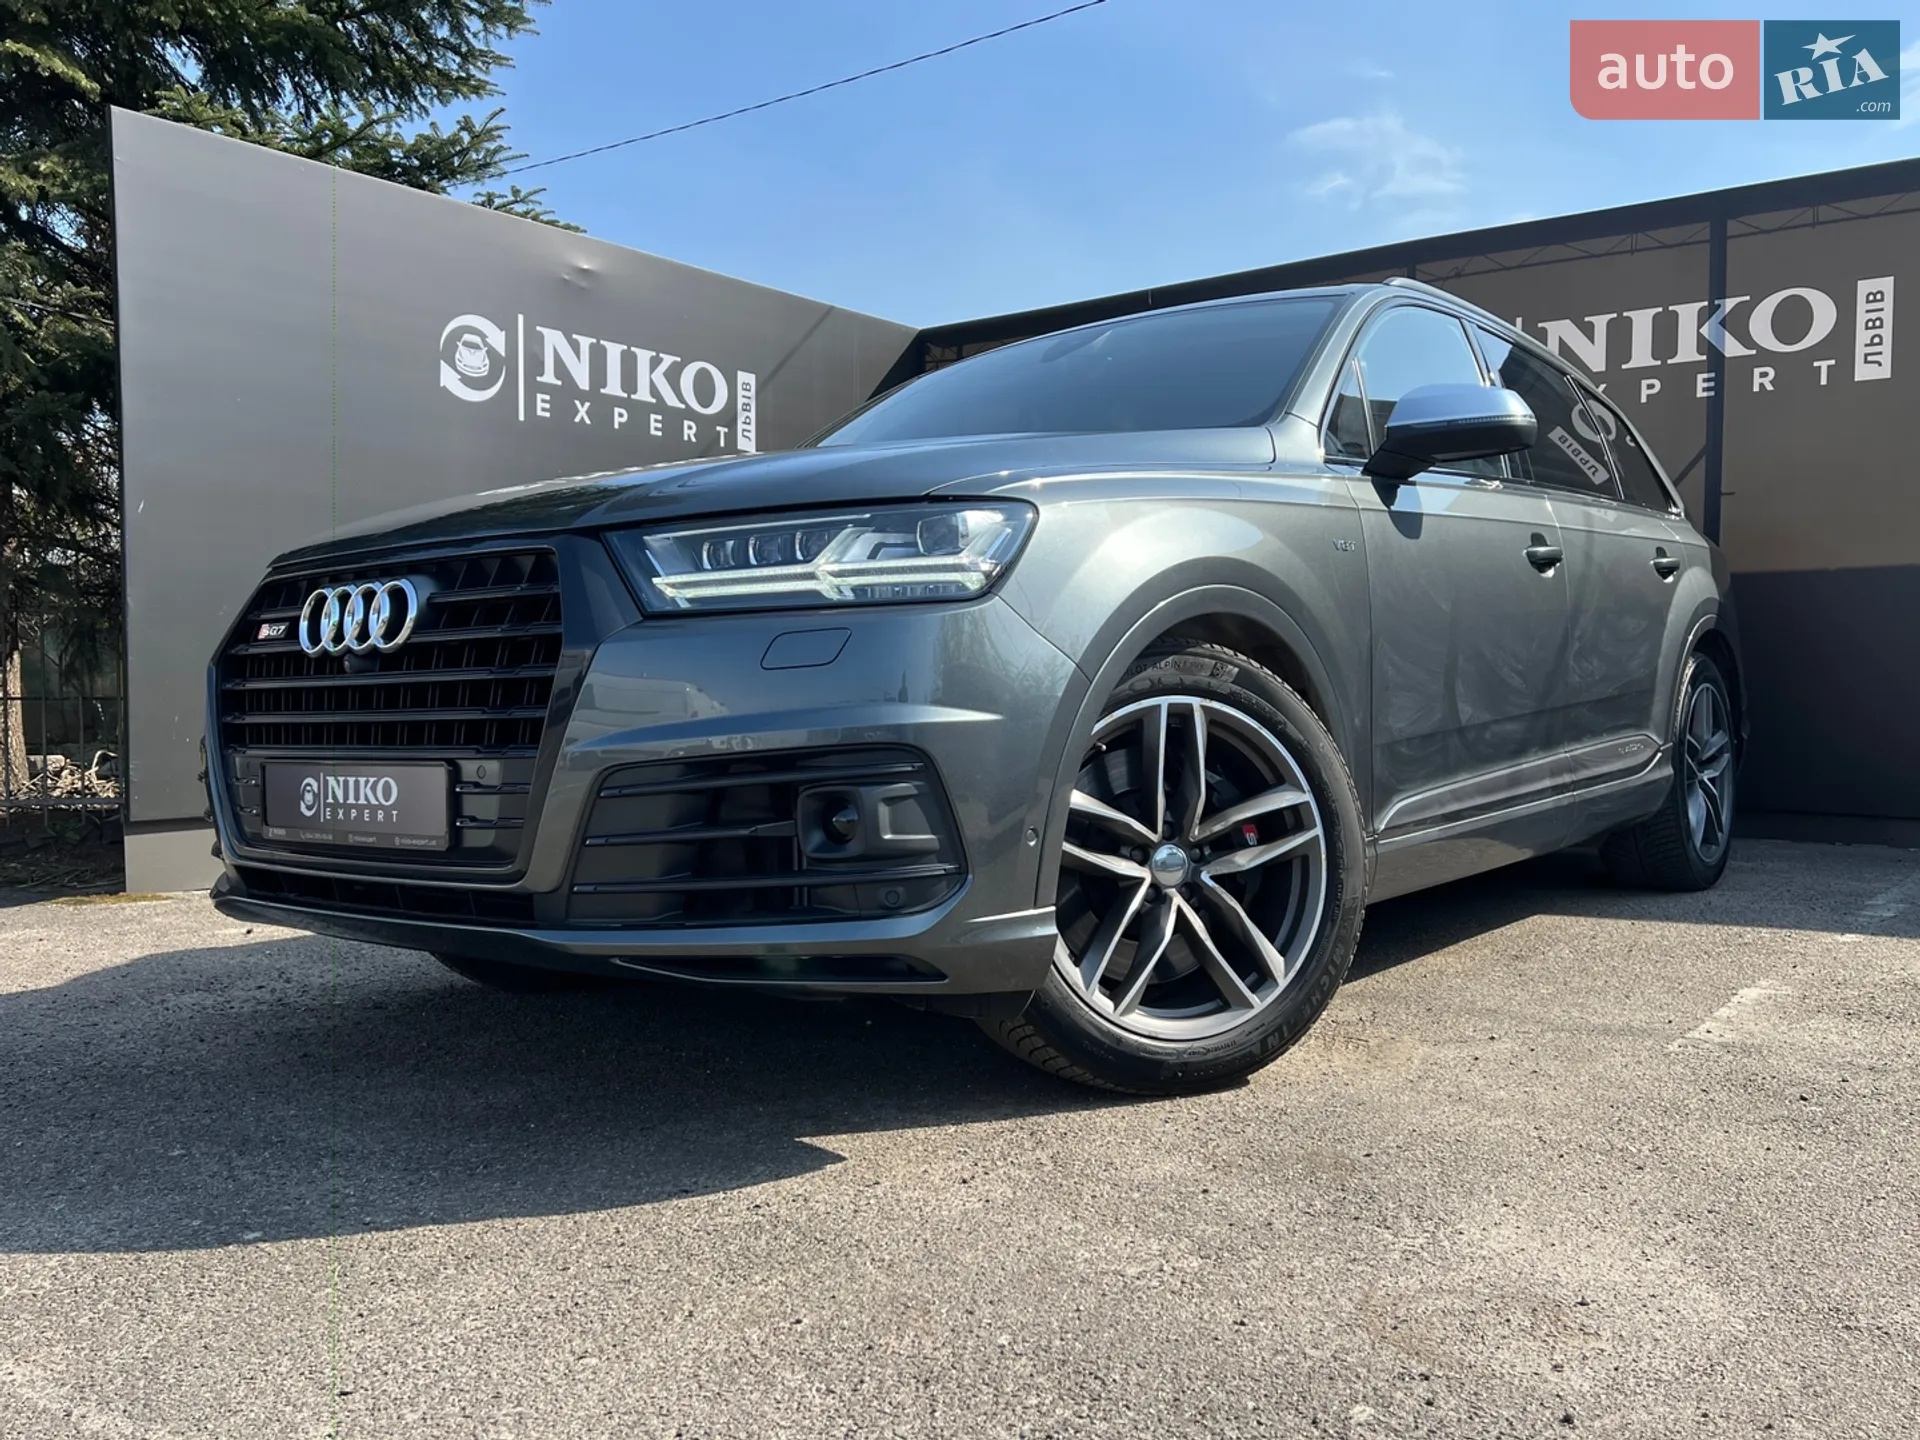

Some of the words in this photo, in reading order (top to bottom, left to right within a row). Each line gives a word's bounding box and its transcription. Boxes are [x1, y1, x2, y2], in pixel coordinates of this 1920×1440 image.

[1537, 287, 1838, 373] NIKO
[536, 326, 728, 415] NIKO
[536, 393, 729, 448] EXPERT
[326, 776, 398, 806] NIKO
[326, 808, 398, 823] EXPERT
